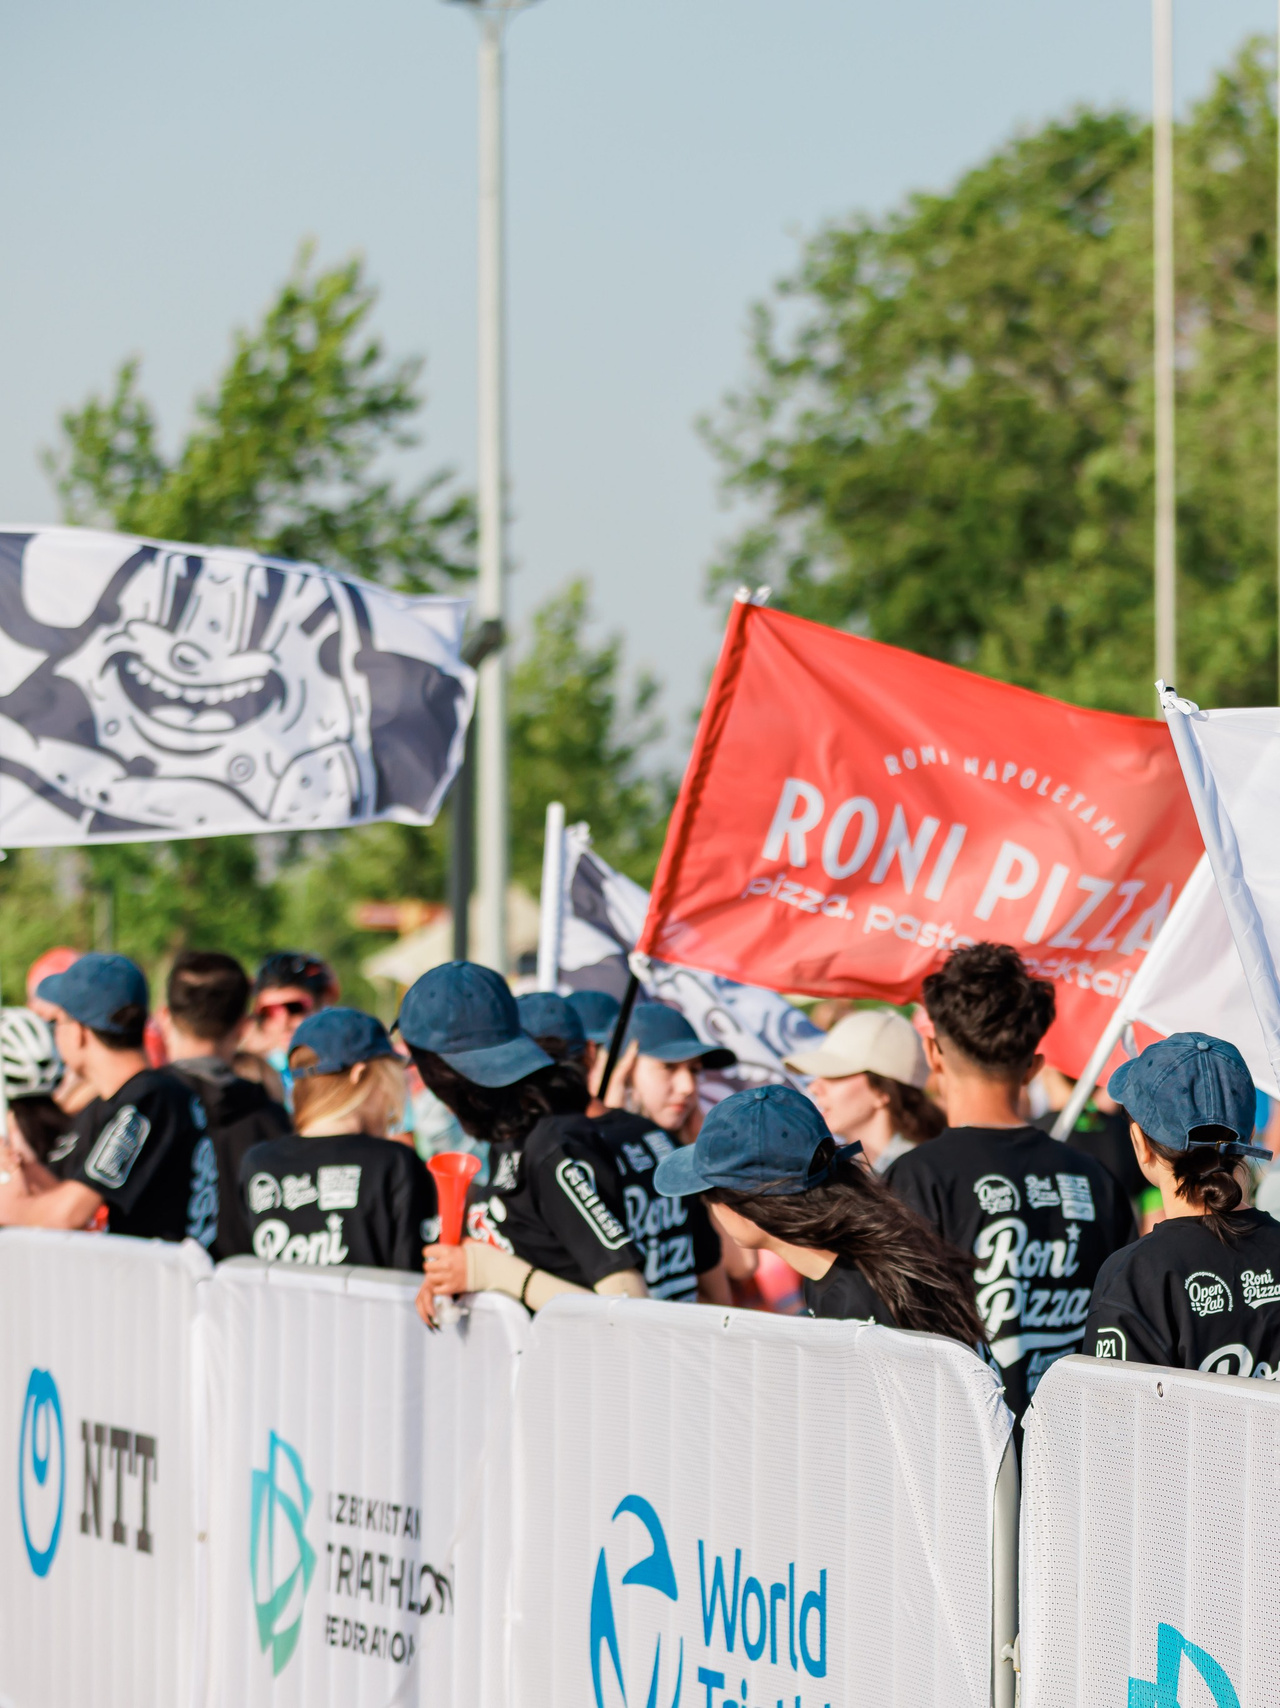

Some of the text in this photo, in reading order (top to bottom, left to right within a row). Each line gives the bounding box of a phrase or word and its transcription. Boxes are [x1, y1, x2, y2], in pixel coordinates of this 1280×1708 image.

[884, 745, 1127, 850] RONI NAPOLETANA
[761, 777, 1174, 956] RONI PIZZA
[974, 1217, 1080, 1284] Roni
[1240, 1268, 1275, 1288] Roni
[976, 1277, 1092, 1342] Pizza
[1188, 1282, 1223, 1302] Open
[1198, 1295, 1224, 1317] Lab
[80, 1419, 158, 1556] NTT
[698, 1538, 827, 1678] World
